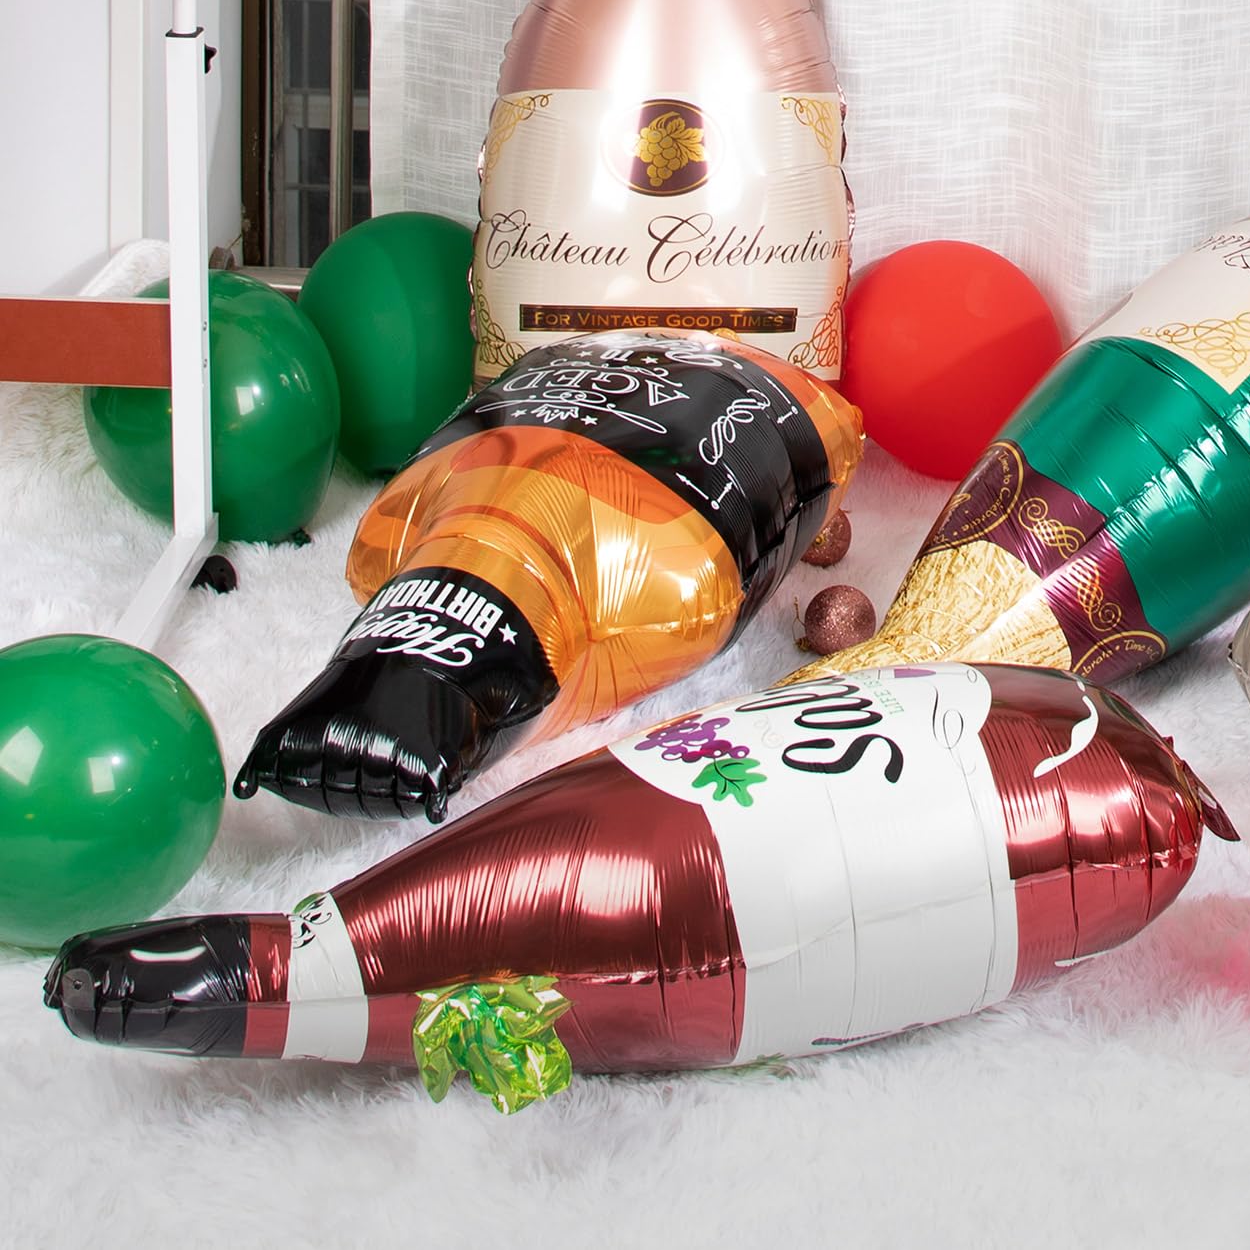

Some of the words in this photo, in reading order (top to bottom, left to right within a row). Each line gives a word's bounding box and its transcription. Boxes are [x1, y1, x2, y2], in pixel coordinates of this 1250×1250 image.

[484, 208, 632, 271] Château
[645, 211, 852, 284] Célébration
[532, 310, 571, 327] FOR
[577, 310, 659, 328] VINTAGE
[663, 312, 724, 328] GOOD
[729, 312, 785, 328] TIMES
[599, 348, 635, 363] TO
[501, 367, 692, 407] AGED
